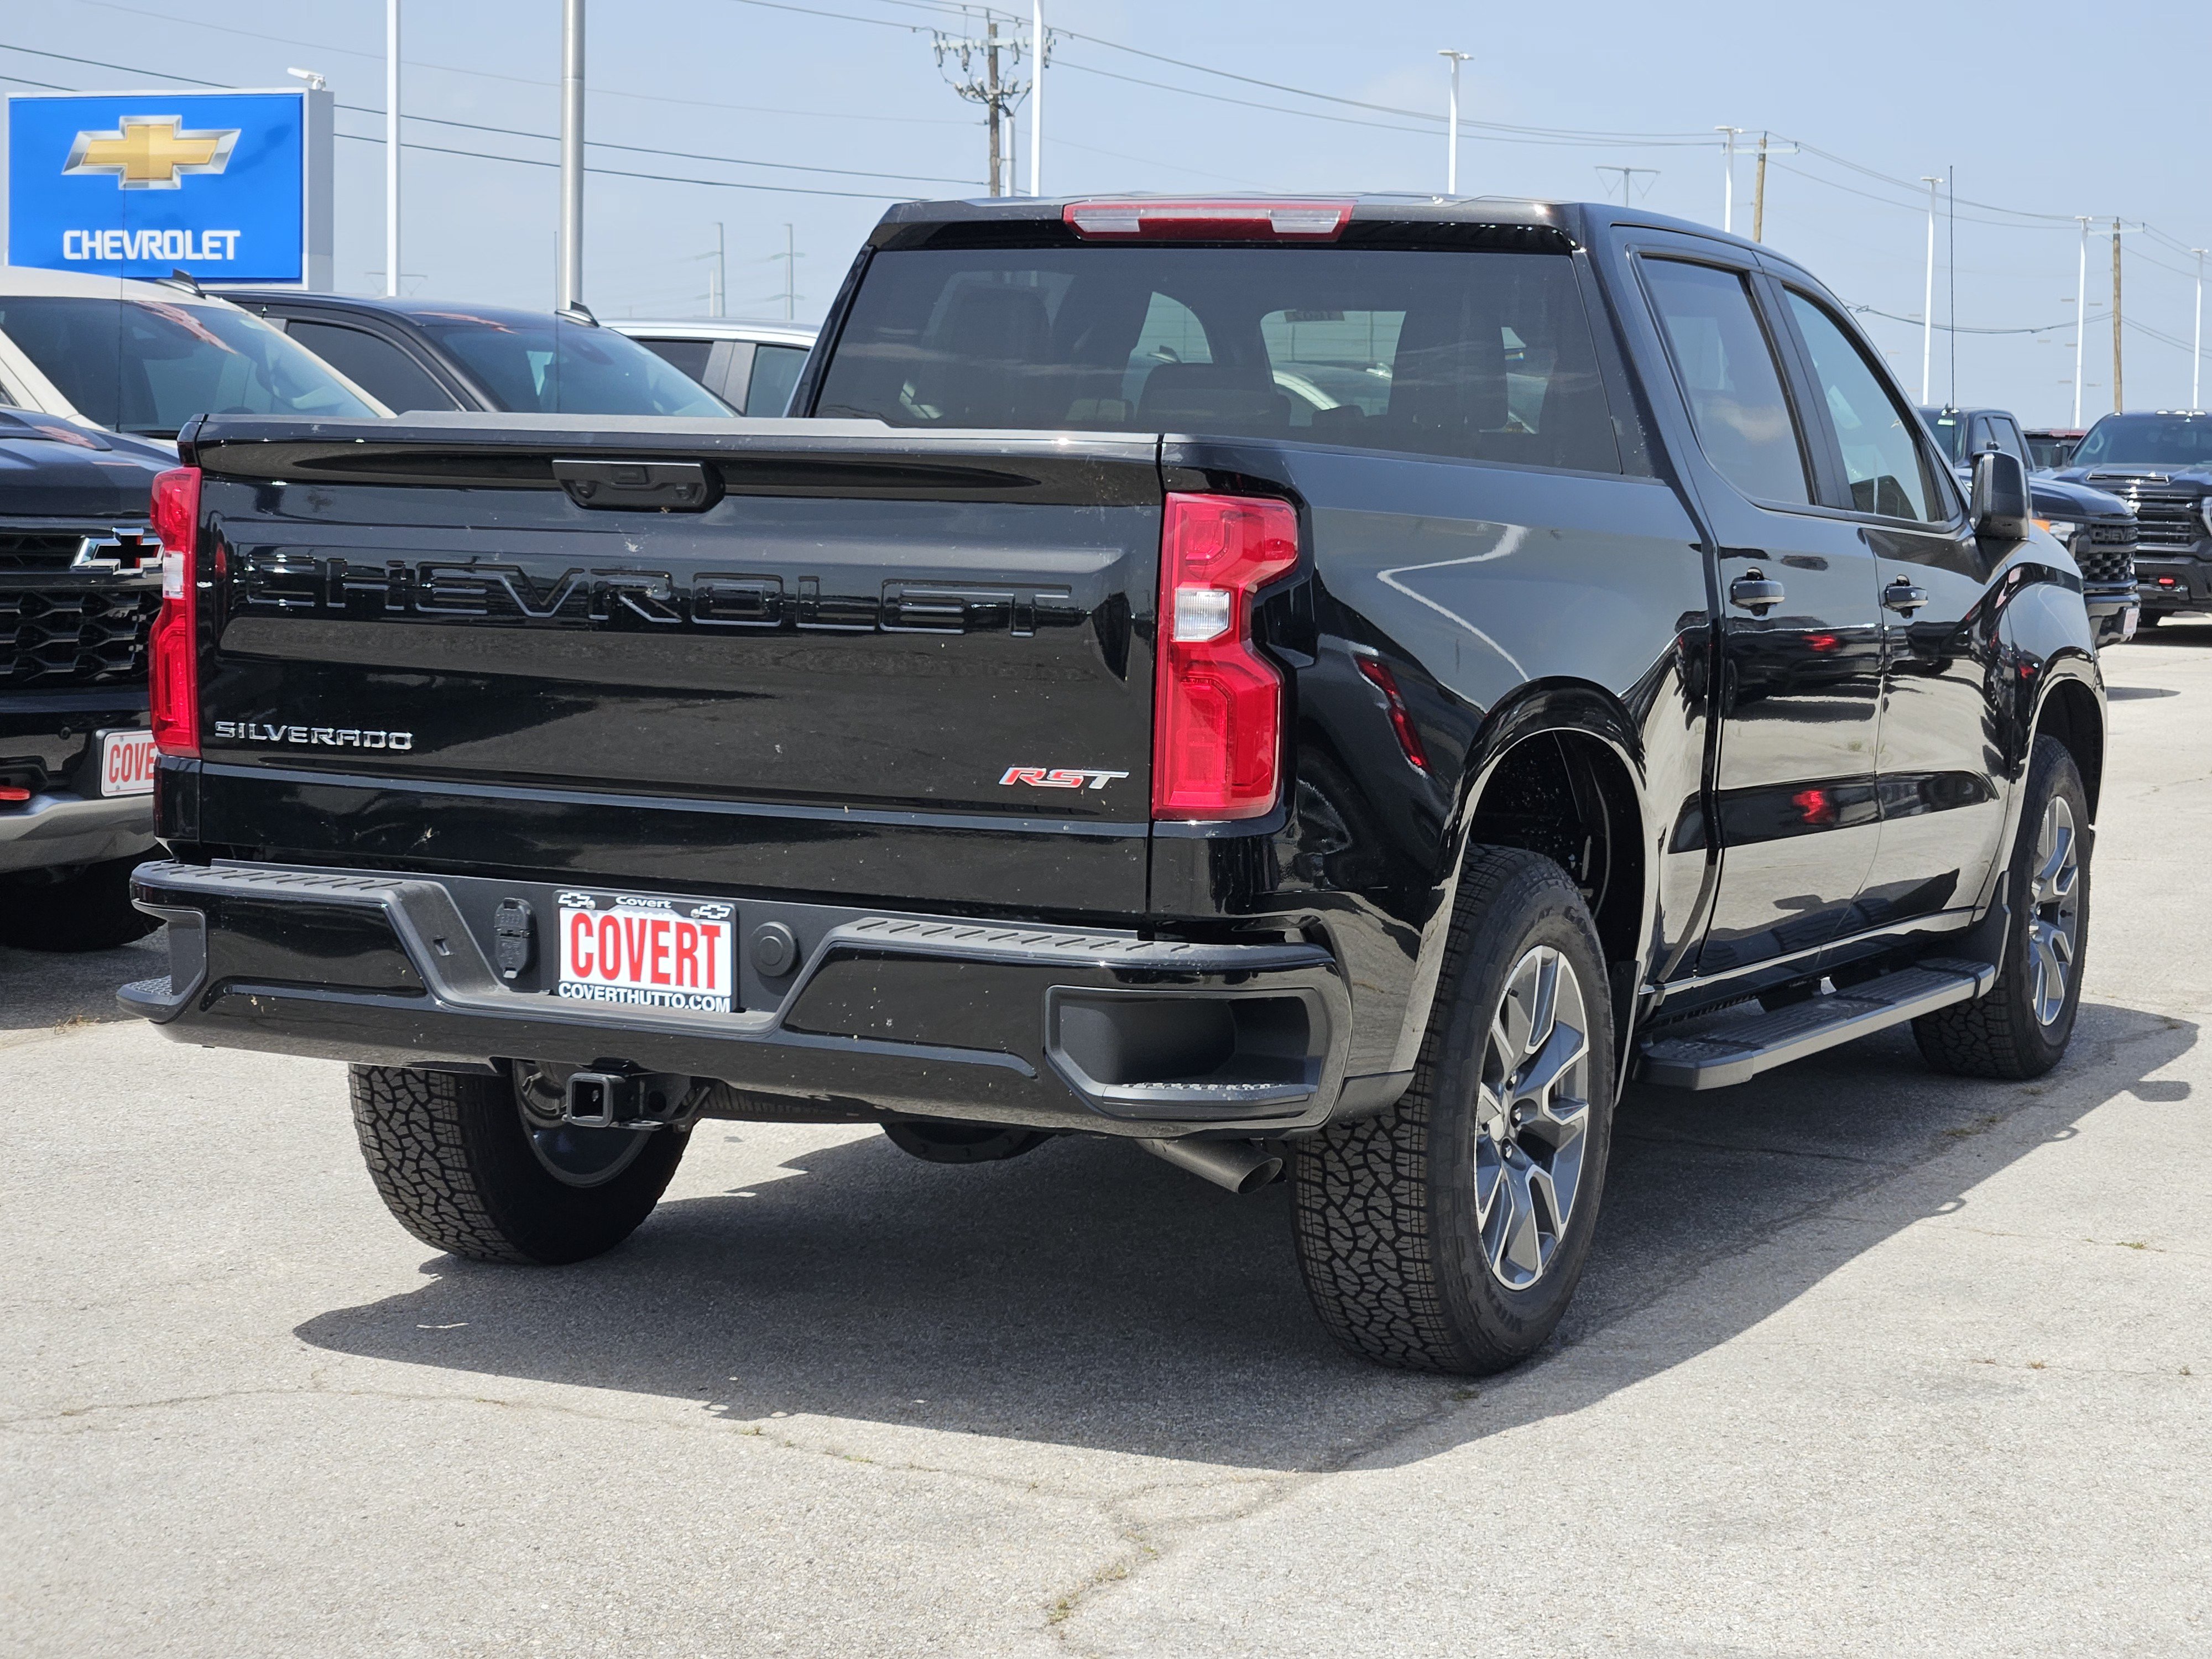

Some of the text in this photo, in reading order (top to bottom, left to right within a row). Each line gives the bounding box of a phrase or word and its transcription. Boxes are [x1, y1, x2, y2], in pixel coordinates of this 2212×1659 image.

[63, 229, 241, 260] CHEVROLET
[2092, 526, 2138, 542] CHEVR
[247, 554, 1072, 638] CHEVROLET
[215, 721, 413, 750] SILVERADO
[109, 743, 155, 783] COVE
[999, 766, 1130, 790] RST
[615, 896, 672, 909] Covert
[571, 912, 722, 989] COVERT
[559, 982, 731, 1013] COVERTHUTTO.COM
